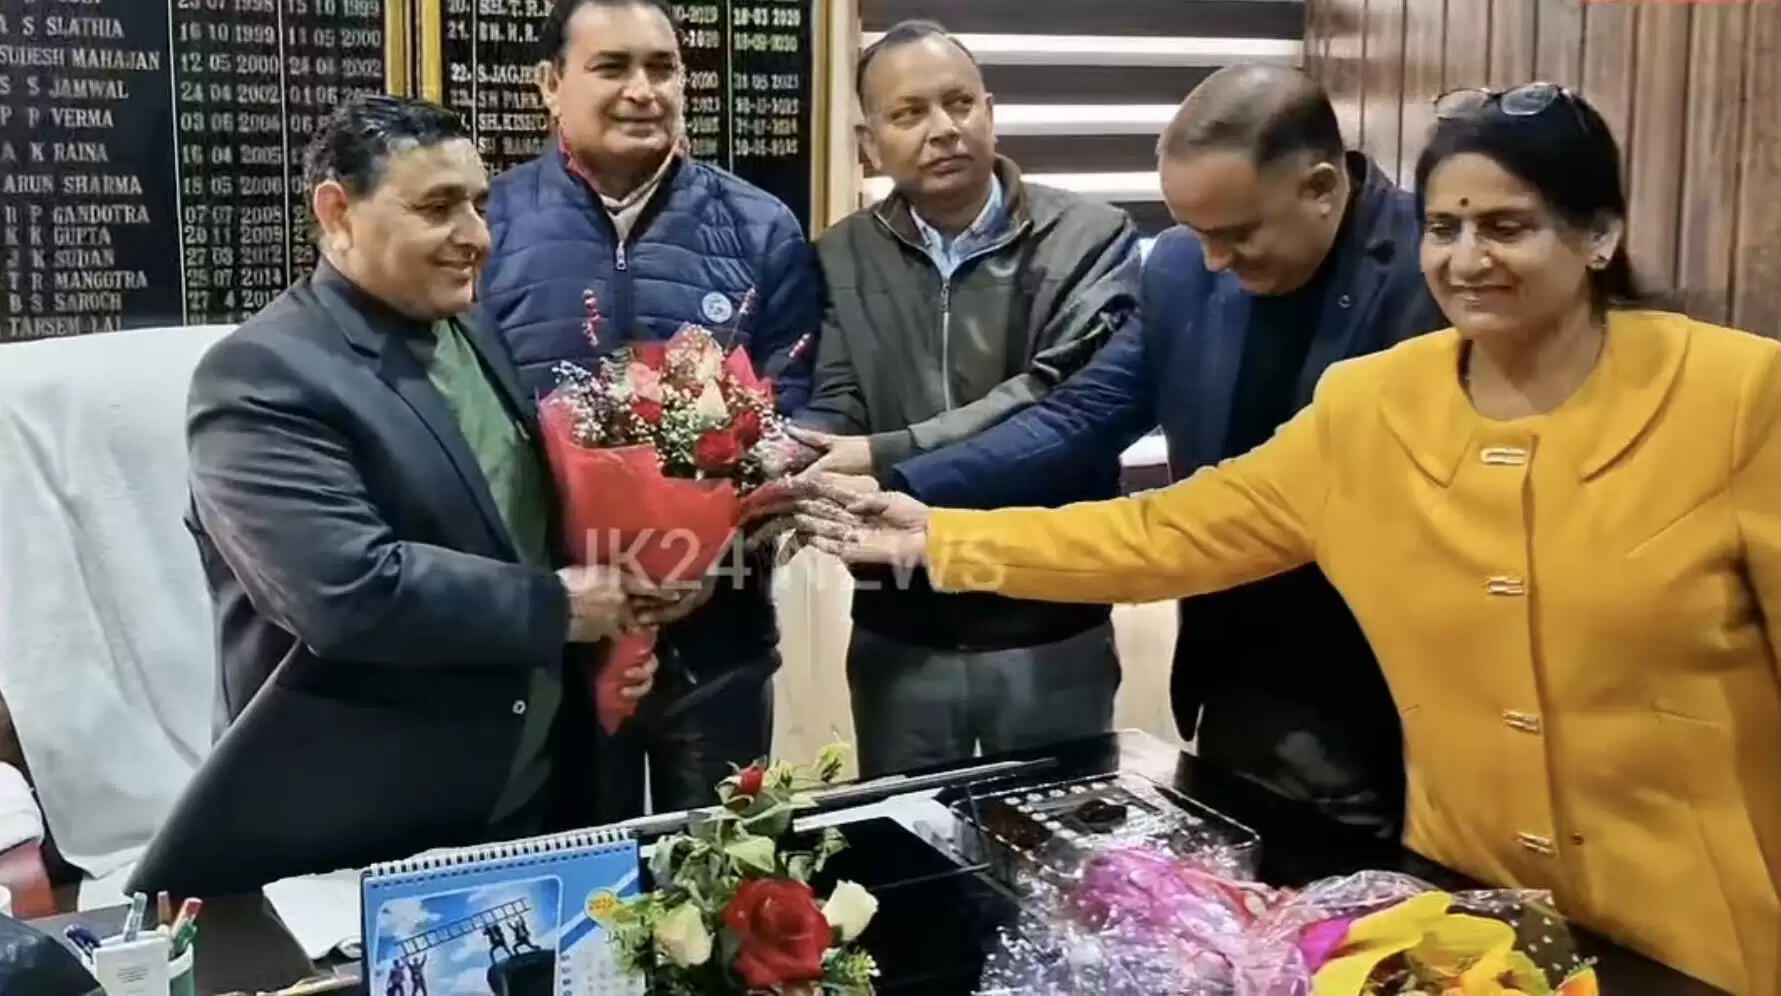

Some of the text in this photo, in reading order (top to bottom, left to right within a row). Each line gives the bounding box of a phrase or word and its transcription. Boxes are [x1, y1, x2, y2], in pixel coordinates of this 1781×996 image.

[22, 16, 35, 36] S
[46, 16, 125, 38] SLATHIA
[208, 23, 229, 41] 10
[341, 29, 382, 48] 2000
[72, 48, 160, 70] MAHAJAN
[181, 52, 280, 74] 12 05 2000
[0, 75, 129, 99] S S JAMWAL
[181, 81, 204, 103] 24
[237, 84, 281, 104] 2002
[0, 105, 114, 129] P P VERMA
[1, 141, 108, 163] A K RAINA
[3, 174, 143, 195] ARUN SHARMA
[30, 205, 42, 224] P
[53, 204, 150, 224] GANDOTRA
[185, 204, 207, 224] 07
[30, 226, 41, 245] K
[53, 225, 112, 246] GUPTA
[184, 225, 208, 244] 20
[32, 248, 45, 269] K
[54, 249, 115, 268] SUDAN
[186, 246, 207, 266] 27
[8, 271, 20, 290] T
[54, 270, 148, 290] MANGOTRA
[54, 291, 122, 313] SAROCH
